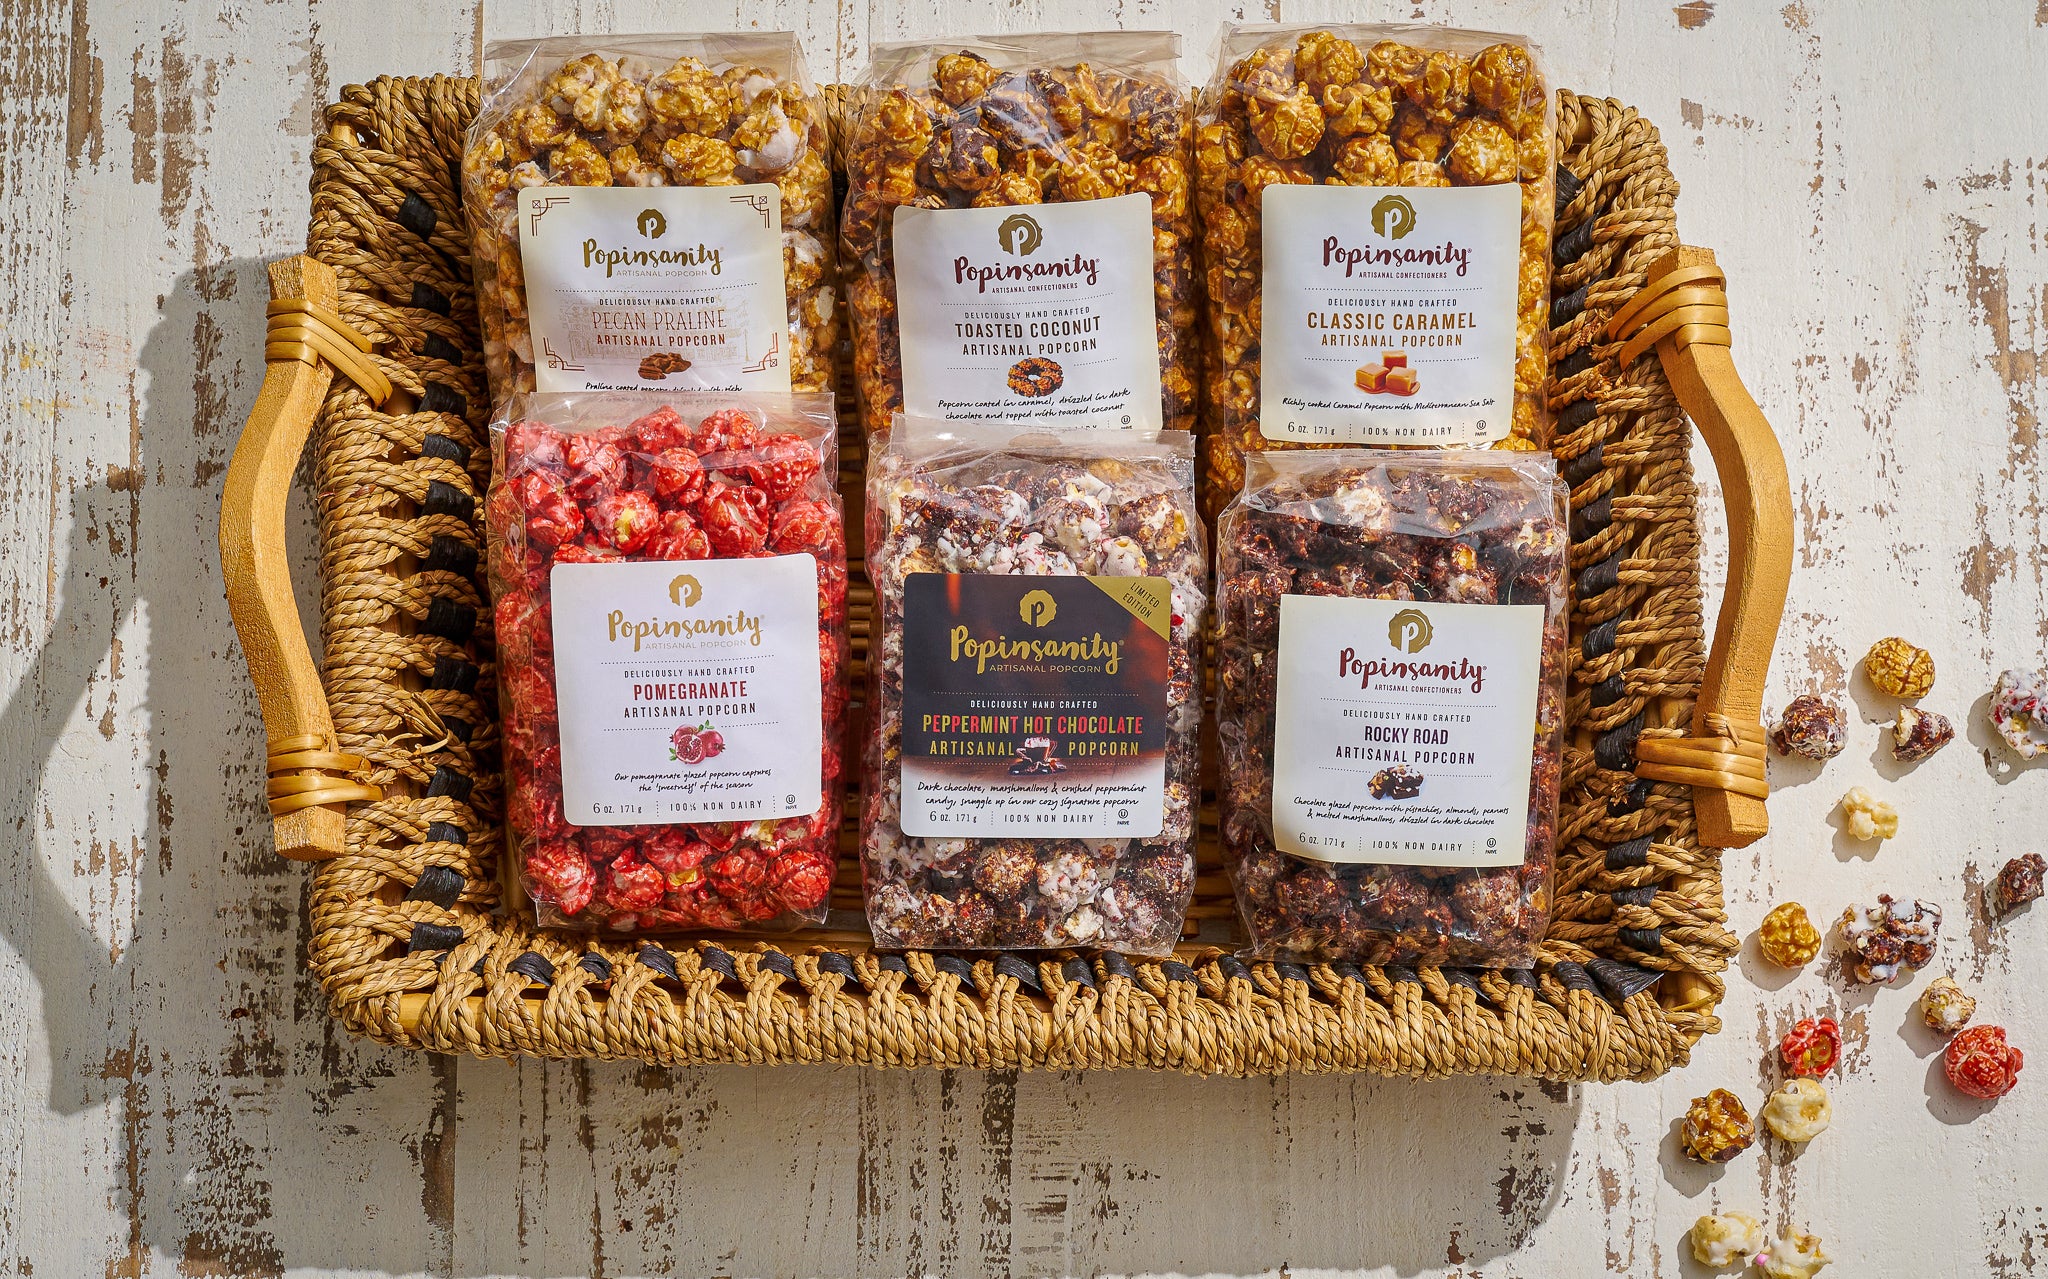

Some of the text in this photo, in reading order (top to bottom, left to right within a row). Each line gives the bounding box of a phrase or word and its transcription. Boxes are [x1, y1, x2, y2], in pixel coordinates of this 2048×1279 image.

[992, 282, 1078, 294] ARTISANAL CONFECTIONERS
[600, 298, 651, 306] DELICIOUSLY
[680, 297, 715, 305] CRAFTED
[1328, 299, 1386, 307] DELICIOUSLY
[1419, 299, 1457, 307] CRAFTED
[1053, 307, 1090, 316] CRAFTED
[592, 309, 727, 331] PECAN PRALINE
[955, 316, 1100, 338] TOASTED COCONUT
[1307, 312, 1476, 330] CLASSIC CARAMEL
[597, 334, 725, 347] ARTISANAL POPCORN
[962, 338, 1096, 356] ARTISANAL POPCORN
[1322, 334, 1462, 347] ARTISANAL POPCORN
[938, 400, 973, 410] Popcorn
[1018, 397, 1055, 406] caramel,
[1059, 394, 1092, 403] drizzled
[1109, 388, 1130, 399] dark
[1282, 398, 1305, 410] Richly
[1364, 403, 1394, 411] Popcorn
[1414, 402, 1468, 410] Mediterranean
[1482, 398, 1495, 407] Salt
[1006, 410, 1031, 420] topped
[1035, 409, 1057, 417] with
[1059, 406, 1088, 416] toasted
[1092, 403, 1125, 413] coconut
[1288, 422, 1294, 432] 6
[1363, 427, 1388, 435] 100%
[1395, 428, 1415, 436] NON
[1423, 427, 1452, 436] DAIRY
[1130, 582, 1160, 608] LIMITED
[1122, 592, 1153, 619] EDITION
[646, 640, 746, 650] ARTISANAL POPCORN
[624, 669, 683, 678] DELICIOUSLY
[716, 666, 755, 676] CRAFTED
[990, 664, 1101, 673] ARTISANAL POPCORN
[634, 681, 747, 700] POMEGRANATE
[1375, 684, 1462, 694] ARTISANAL CONFECTIONERS
[624, 703, 756, 718] ARTISANAL POPCORN
[970, 700, 1098, 709] DELICIOUSLY HAND CRAFTED
[1344, 710, 1471, 722] DELICIOUSLY HAND CRAFTED
[923, 715, 1143, 734] PEPPERMINT HOT CHOCOLATE
[1364, 726, 1448, 744] ROCKY ROAD
[930, 740, 1138, 756] ARTISANAL POPCORN
[1336, 746, 1475, 764] ARTISANAL POPCORN
[631, 773, 680, 783] pomegranate
[684, 771, 707, 782] glazed
[742, 769, 771, 778] captures
[639, 784, 651, 792] the
[700, 781, 709, 792] of
[918, 782, 1147, 794] Dark chocolate, marshmallows & crushed peppermint
[593, 803, 600, 813] 6
[704, 802, 723, 810] NON
[731, 800, 762, 809] DAIRY
[926, 796, 956, 810] candy,
[961, 797, 992, 808] snuggle
[1008, 797, 1021, 805] in
[1039, 800, 1058, 810] cozy
[1060, 797, 1100, 809] signature
[1294, 797, 1326, 806] Chocolate
[1329, 801, 1351, 810] glazed
[1353, 804, 1382, 812] popcorn
[1385, 804, 1404, 812] with
[1482, 808, 1509, 816] peanuts
[930, 811, 936, 821] 6
[1307, 808, 1313, 818] &
[1316, 811, 1340, 819] melted
[1400, 816, 1428, 824] drizzled
[1300, 832, 1305, 842] 6
[1373, 841, 1398, 849] 100%
[1405, 842, 1424, 850] NON
[1432, 843, 1462, 851] DAIRY
